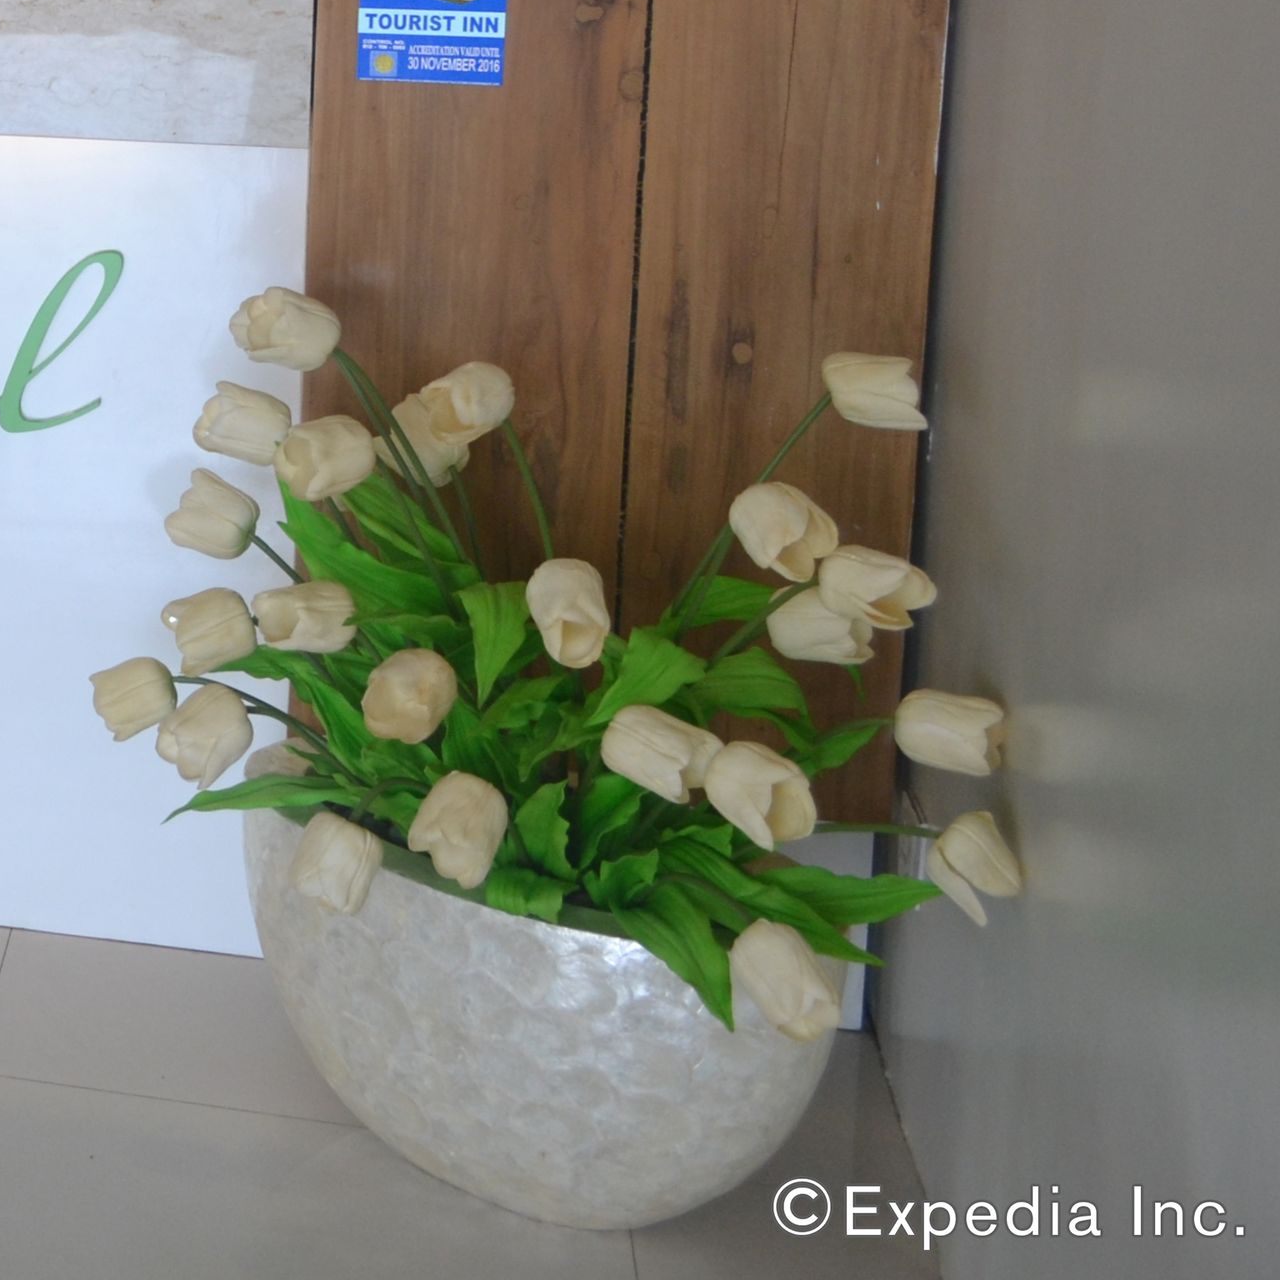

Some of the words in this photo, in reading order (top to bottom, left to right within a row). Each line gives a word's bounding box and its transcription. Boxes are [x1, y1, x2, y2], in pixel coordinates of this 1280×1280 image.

[365, 13, 455, 32] TOURIST
[463, 16, 499, 33] INN
[408, 45, 459, 56] ACCREDITATION
[460, 47, 480, 57] VALID
[480, 47, 500, 58] UNTIL
[407, 57, 419, 70] 30
[420, 57, 477, 72] NOVEMBER
[477, 59, 501, 73] 2016
